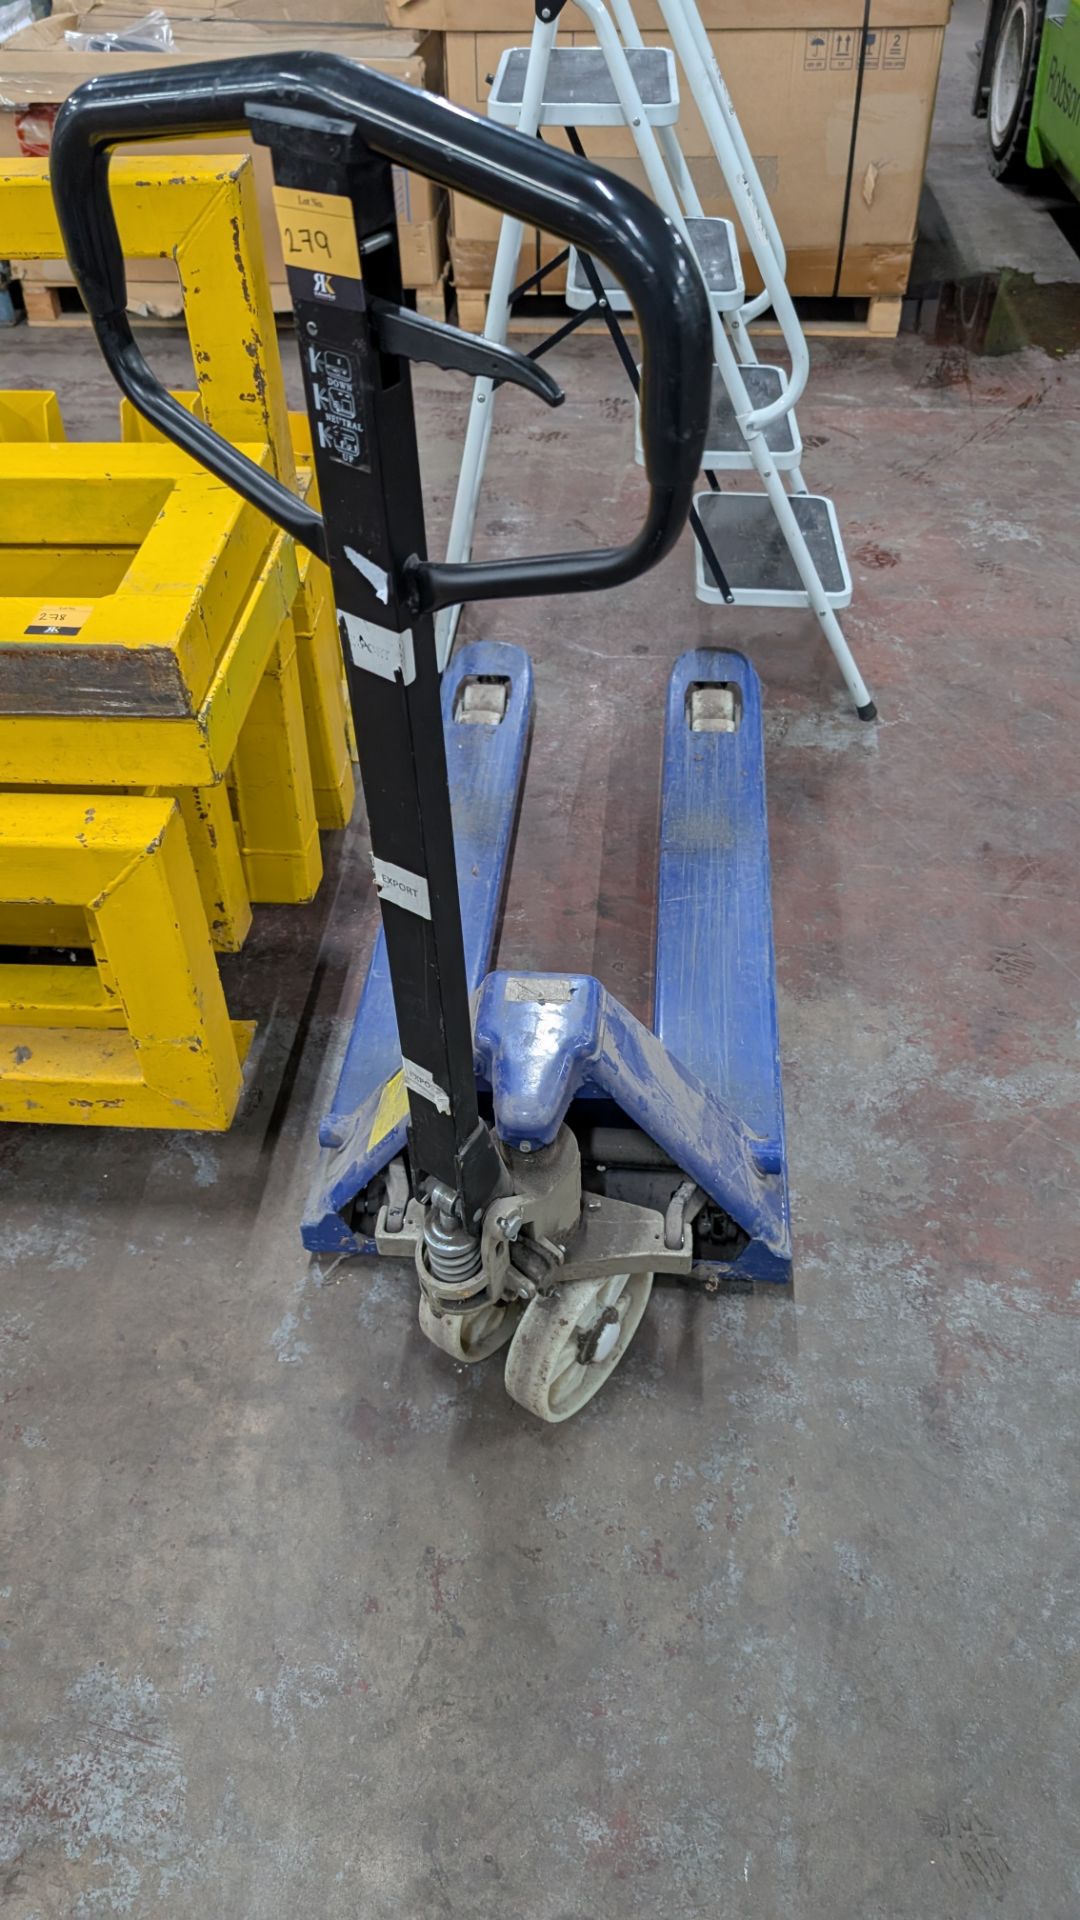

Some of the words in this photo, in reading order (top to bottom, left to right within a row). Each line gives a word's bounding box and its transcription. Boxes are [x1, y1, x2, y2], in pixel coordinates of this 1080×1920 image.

[893, 34, 902, 47] 2
[284, 228, 332, 259] 279
[327, 377, 352, 391] DOWN
[325, 413, 363, 432] NEUTRAL
[342, 453, 355, 463] UP
[38, 612, 67, 621] 278
[381, 874, 418, 897] EXPORT
